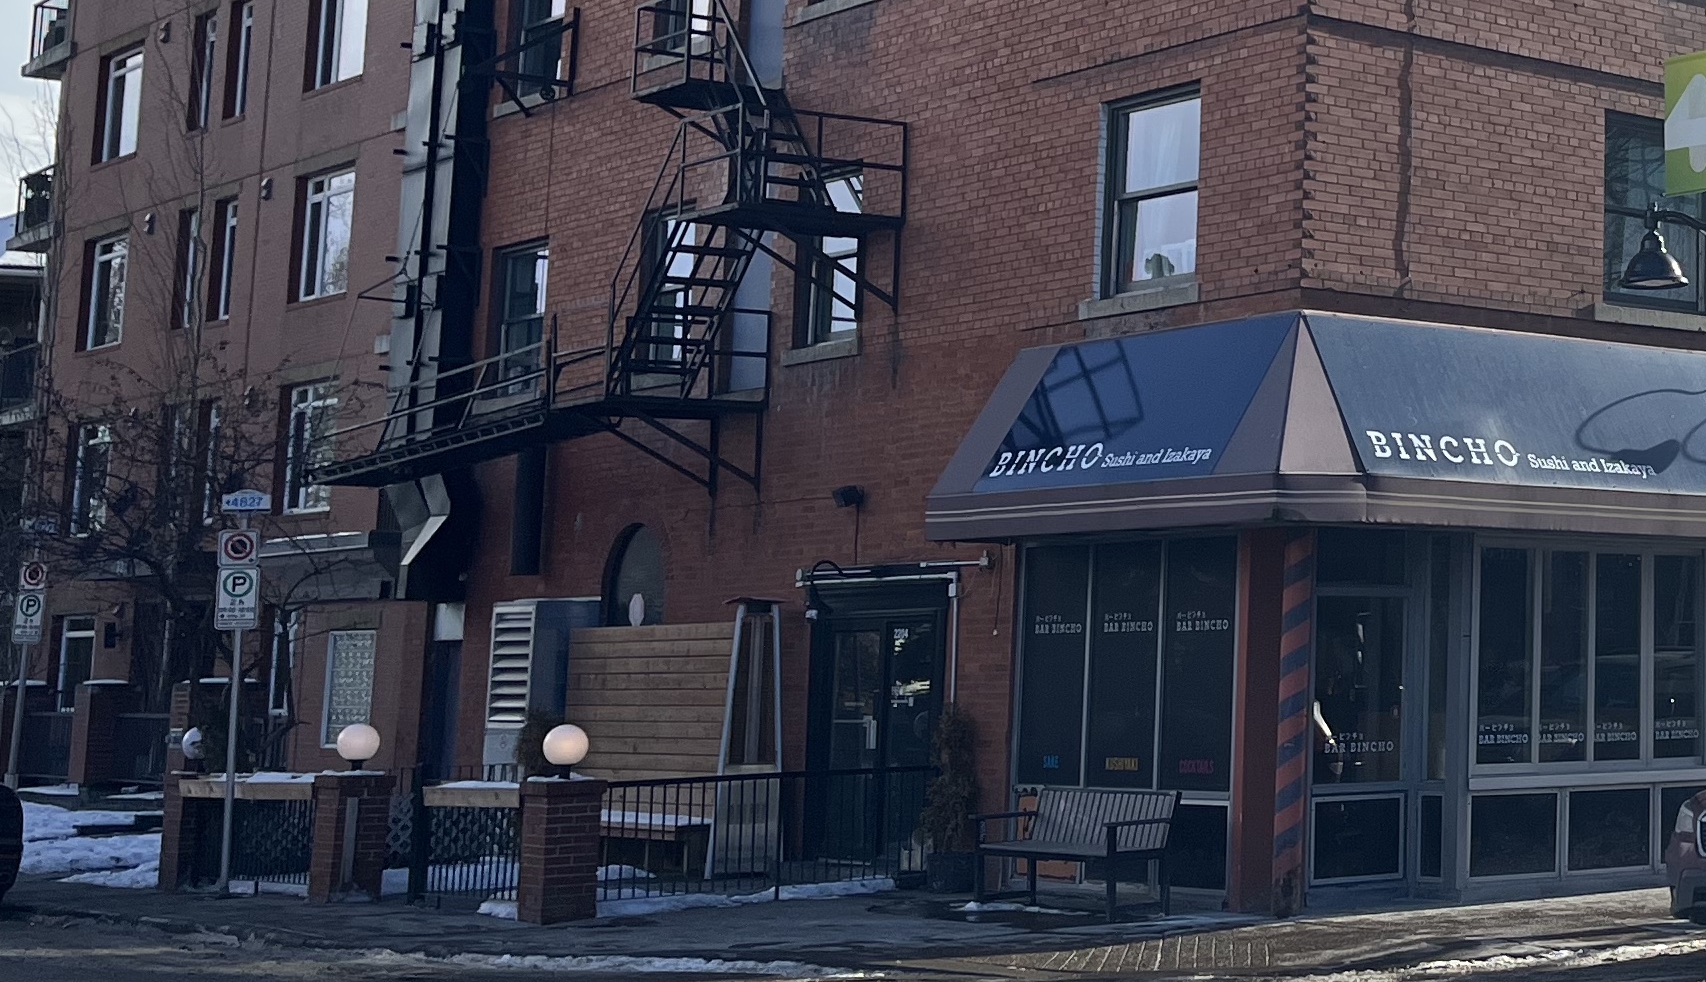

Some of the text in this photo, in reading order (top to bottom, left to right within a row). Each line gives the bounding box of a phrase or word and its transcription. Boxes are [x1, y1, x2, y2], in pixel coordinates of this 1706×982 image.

[989, 443, 1212, 478] BINCHO Sushi and Izakaya
[1366, 430, 1656, 479] BINCHO Sushi and Izakaya
[232, 576, 247, 593] P
[26, 599, 37, 613] P
[1350, 740, 1394, 753] BINCHO
